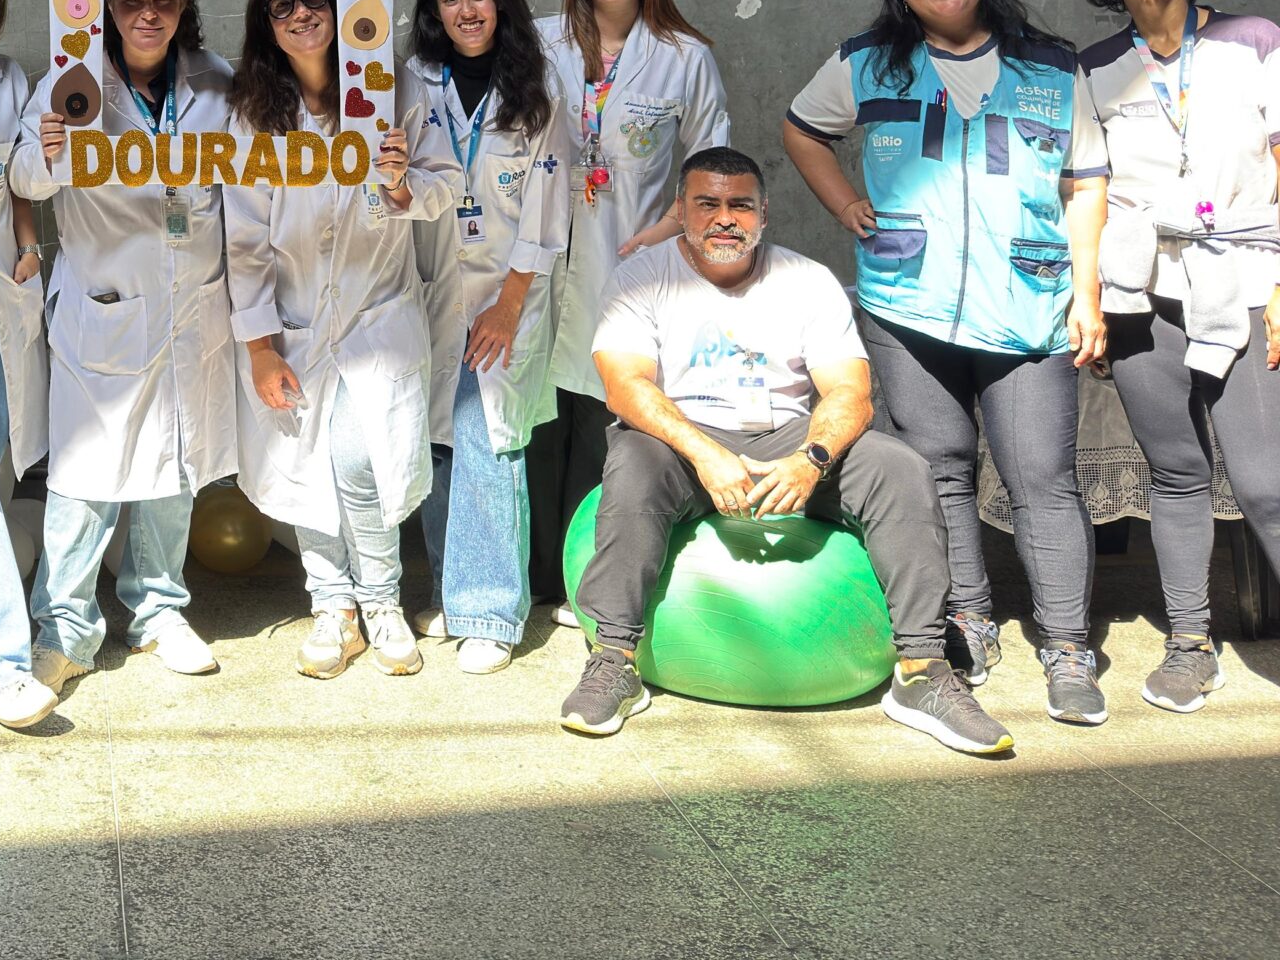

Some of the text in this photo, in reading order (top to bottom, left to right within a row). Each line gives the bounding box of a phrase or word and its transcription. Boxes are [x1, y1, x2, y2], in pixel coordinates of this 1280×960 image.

[1015, 85, 1062, 100] AGENTE
[882, 135, 902, 147] Rio
[70, 129, 370, 187] DOURADO
